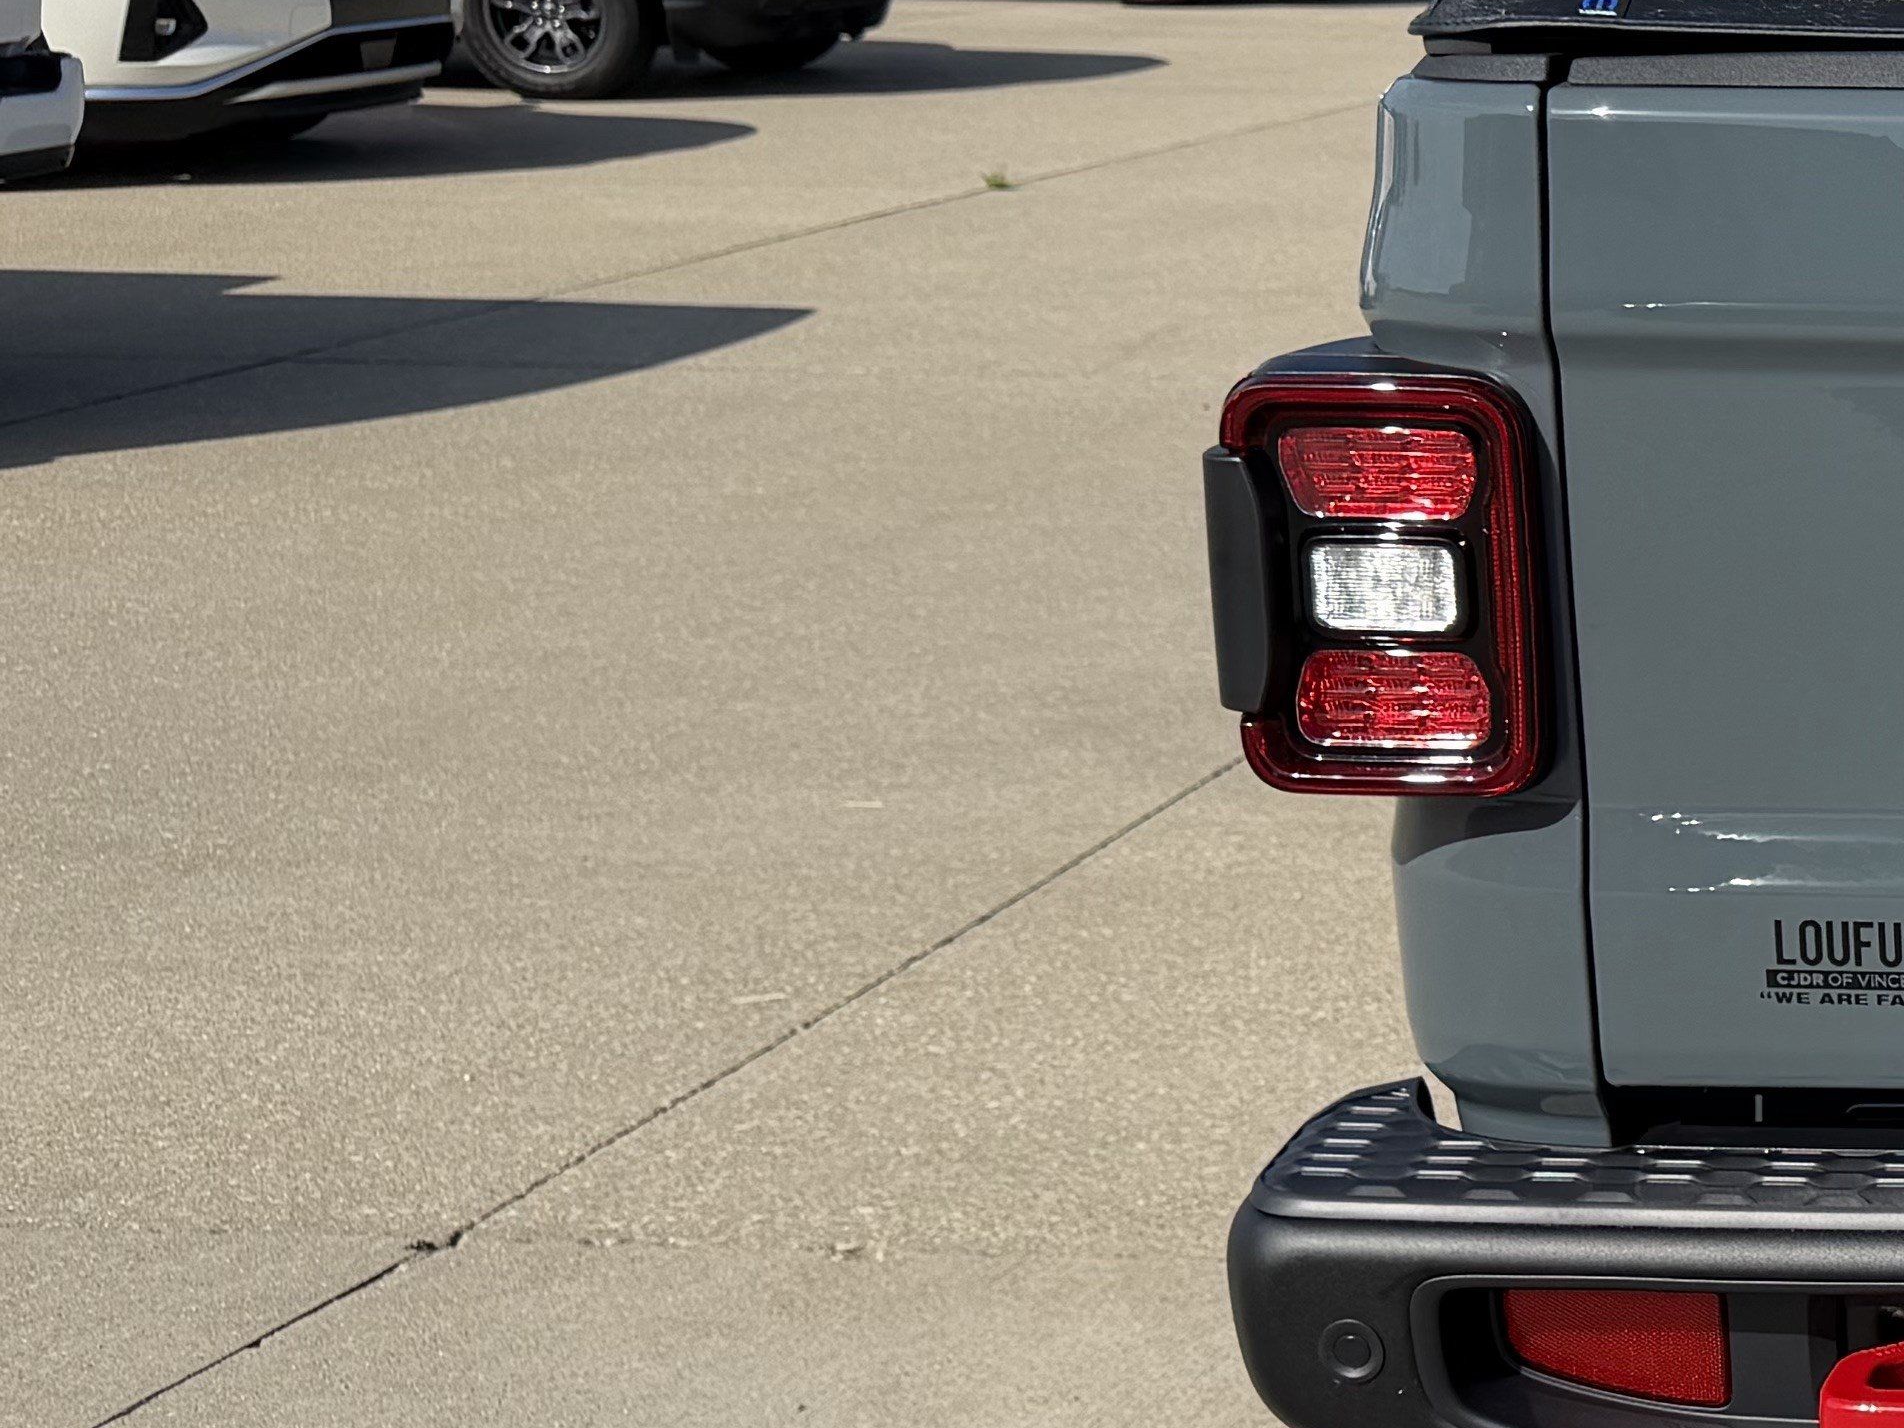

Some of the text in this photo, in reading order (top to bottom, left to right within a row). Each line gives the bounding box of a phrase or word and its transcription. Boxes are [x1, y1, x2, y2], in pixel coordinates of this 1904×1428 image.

[1776, 973, 1824, 986] CJDR
[1828, 974, 1852, 986] OF
[1819, 992, 1869, 1006] ARE
